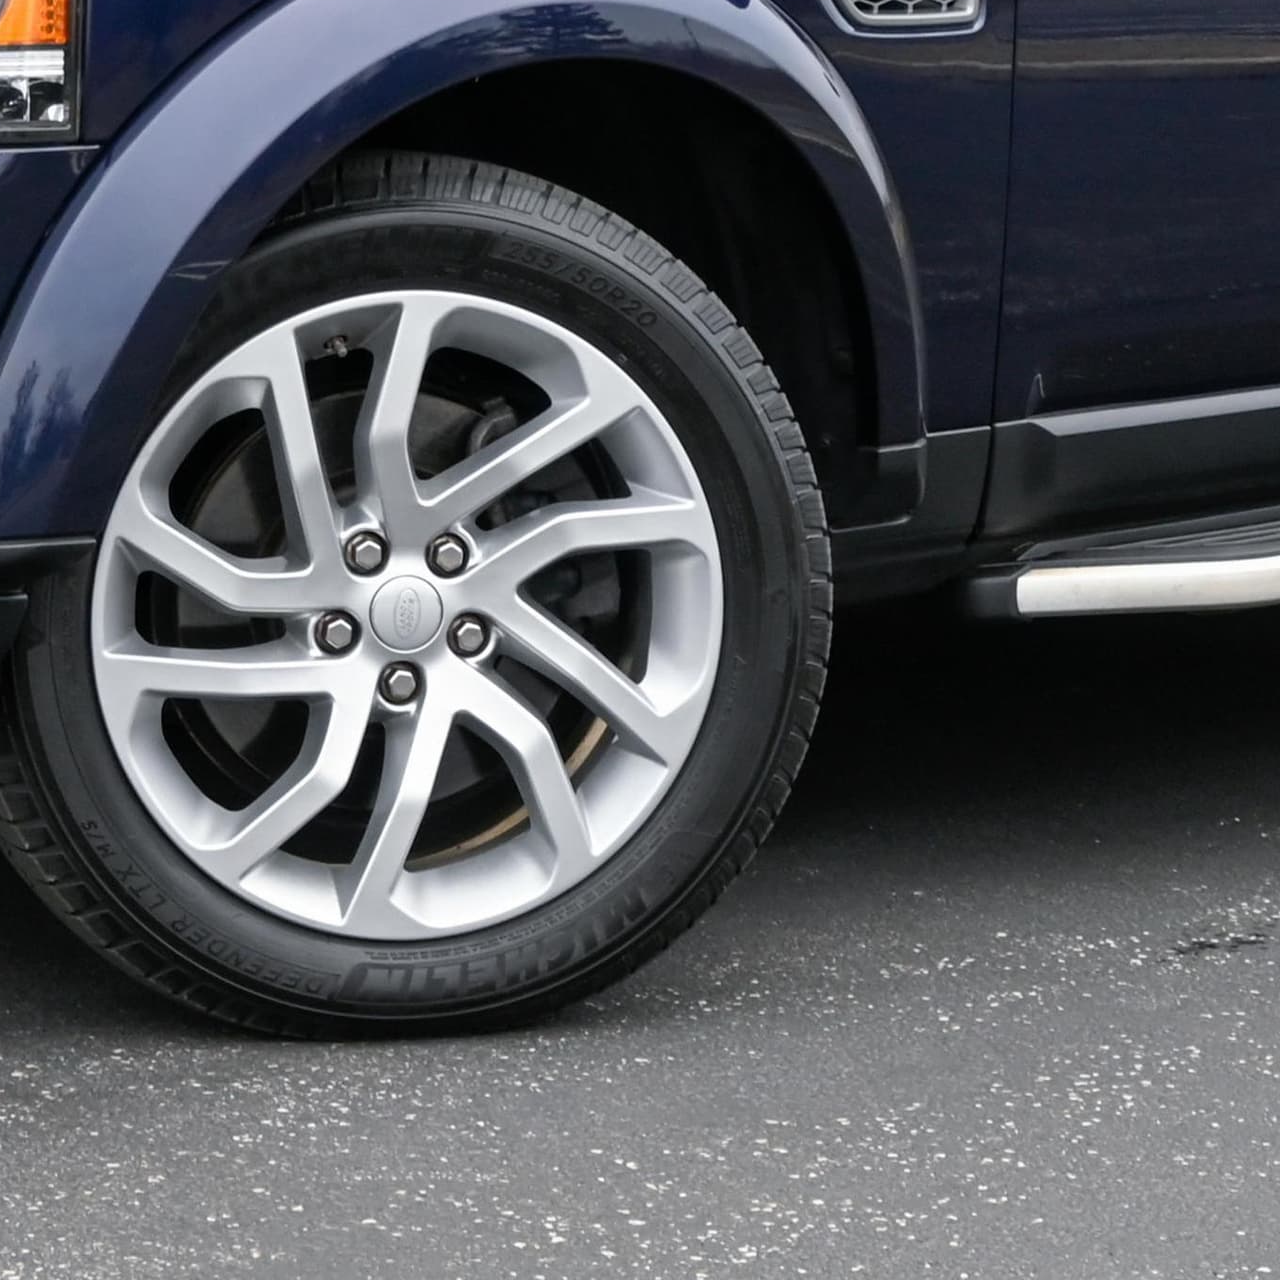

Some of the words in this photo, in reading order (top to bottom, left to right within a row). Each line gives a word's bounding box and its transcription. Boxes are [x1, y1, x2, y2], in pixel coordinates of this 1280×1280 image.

[80, 820, 116, 859] M/S
[117, 866, 169, 912] LTX
[169, 912, 322, 993] DEFENDER
